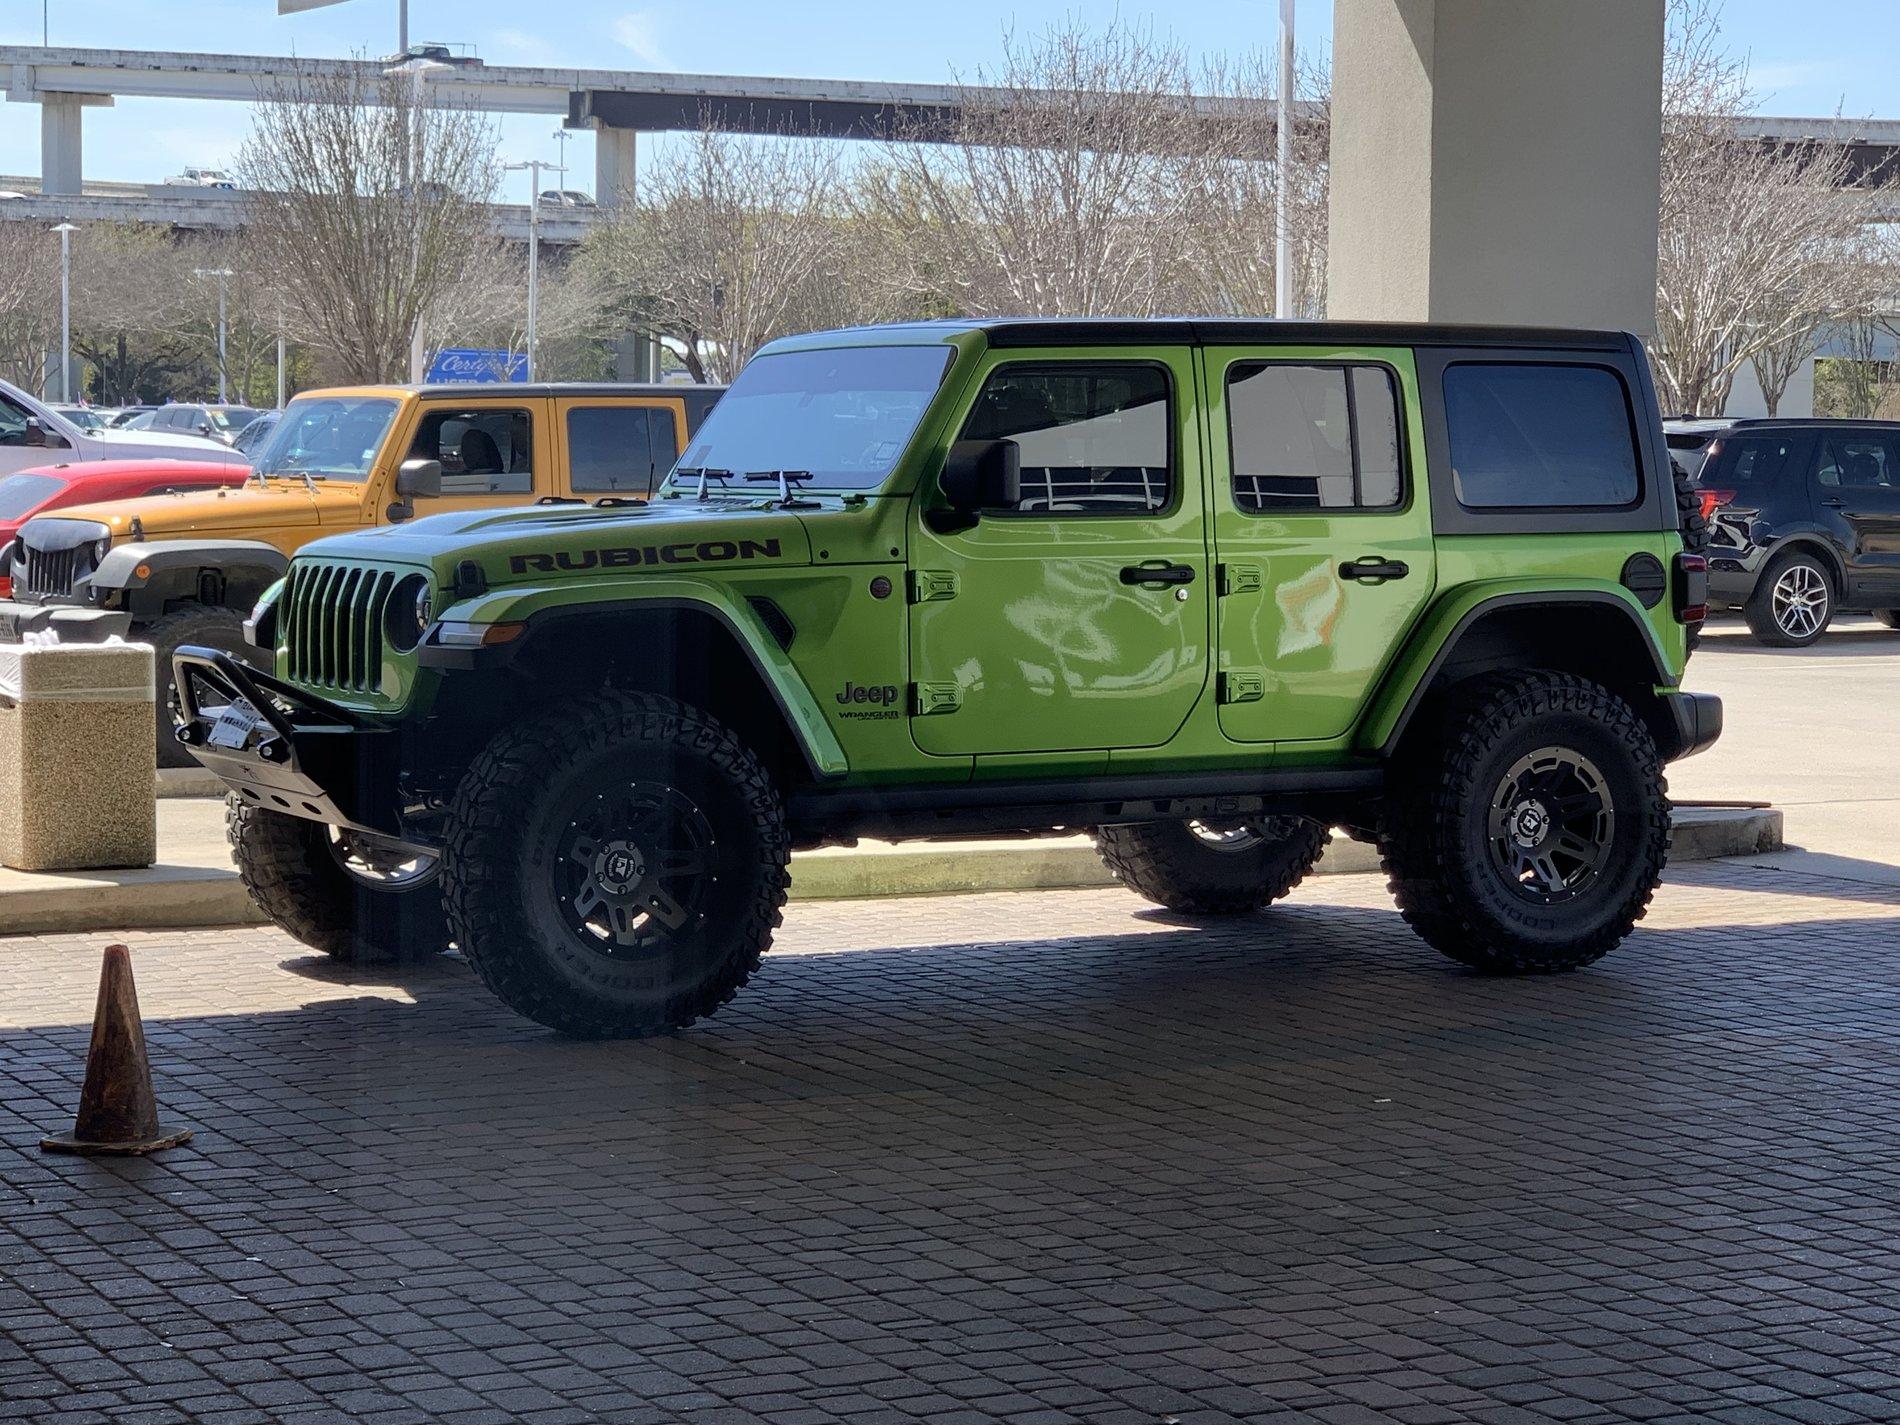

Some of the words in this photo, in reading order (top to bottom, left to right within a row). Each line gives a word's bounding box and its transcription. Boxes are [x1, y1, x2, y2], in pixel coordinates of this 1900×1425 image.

[508, 538, 782, 574] RUBICON
[836, 682, 898, 707] Jeep
[838, 710, 899, 719] WRANGLER
